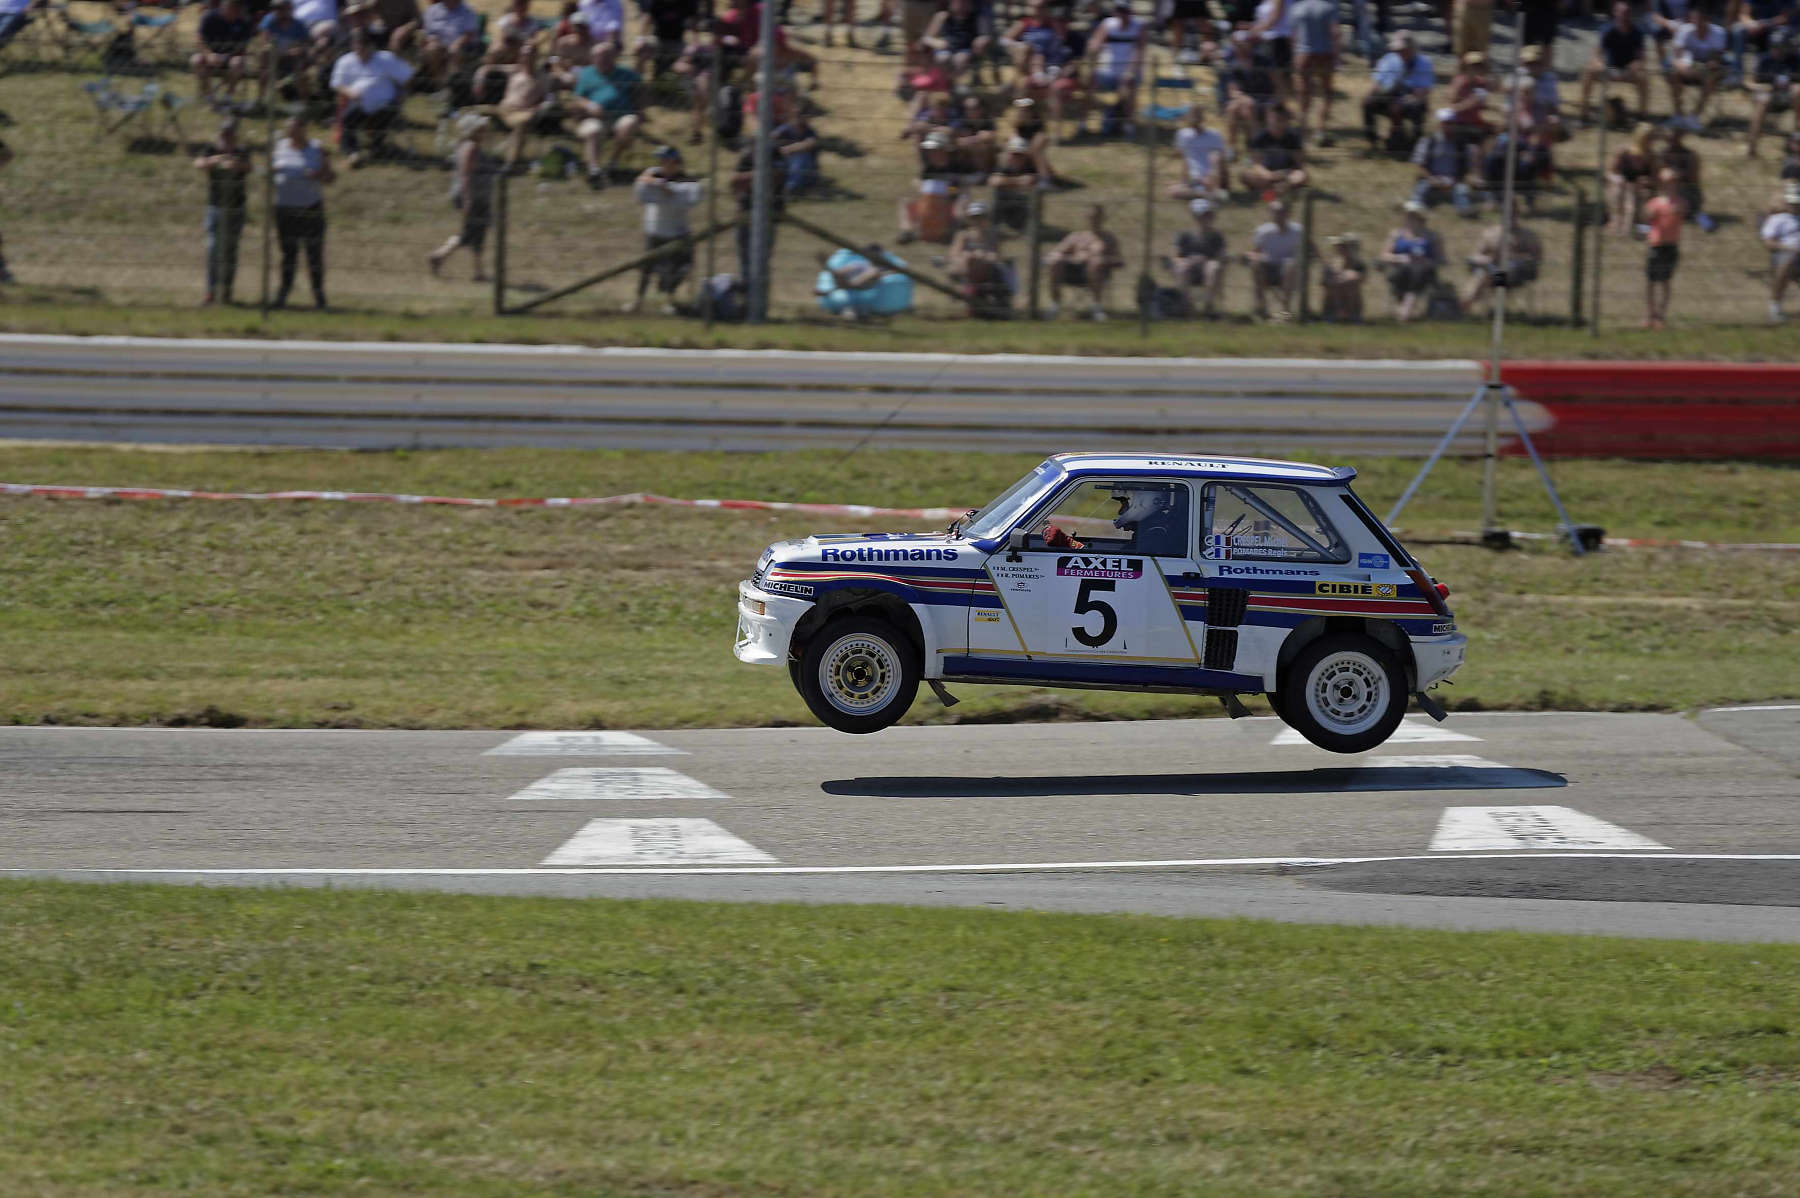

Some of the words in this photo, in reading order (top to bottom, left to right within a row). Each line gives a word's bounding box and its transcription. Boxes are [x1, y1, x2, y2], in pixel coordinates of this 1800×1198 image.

[822, 547, 958, 561] Rothmans
[1066, 556, 1134, 570] AXEL
[1064, 569, 1134, 578] FERMETURES
[1218, 565, 1320, 576] Rothmans
[763, 581, 813, 595] MICHELIN
[1071, 579, 1117, 647] 5
